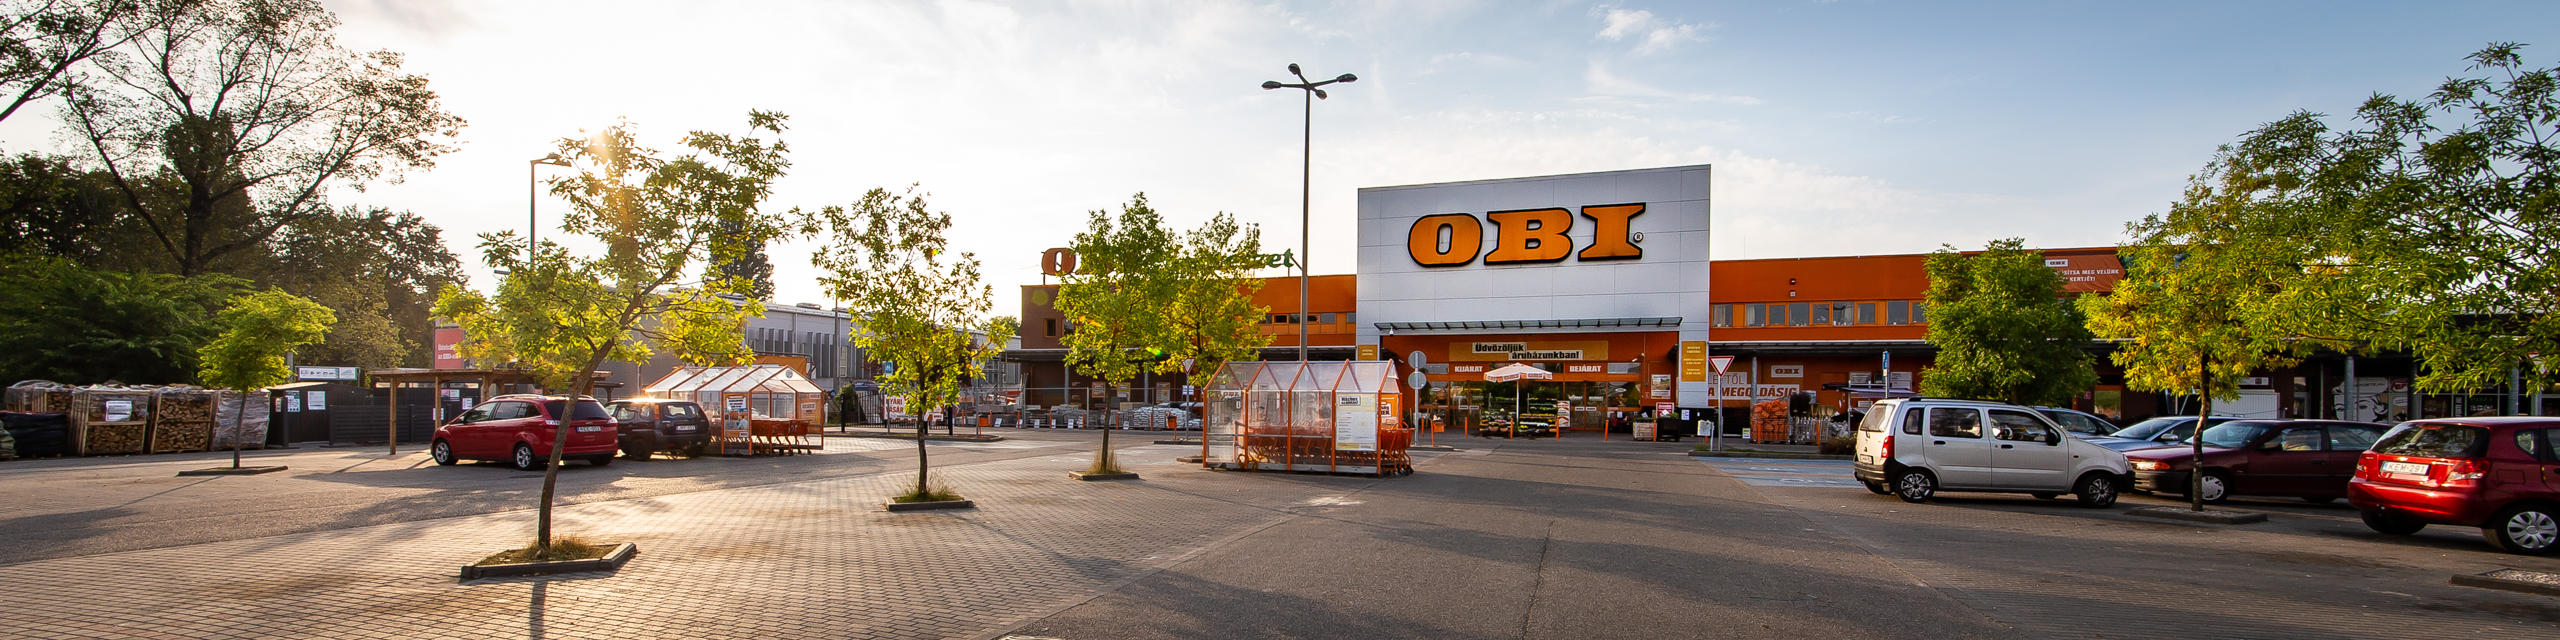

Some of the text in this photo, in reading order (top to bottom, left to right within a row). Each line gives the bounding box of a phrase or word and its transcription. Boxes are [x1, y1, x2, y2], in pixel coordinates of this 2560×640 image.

[1408, 202, 1646, 267] OBI
[1475, 342, 1525, 353] Üdvözöljük
[1512, 351, 1579, 359] áruházunkban!
[1455, 365, 1483, 373] KIJÁRAT
[1569, 364, 1602, 372] BEJÁRAT
[1708, 385, 1797, 397] A MEGODÁSIG
